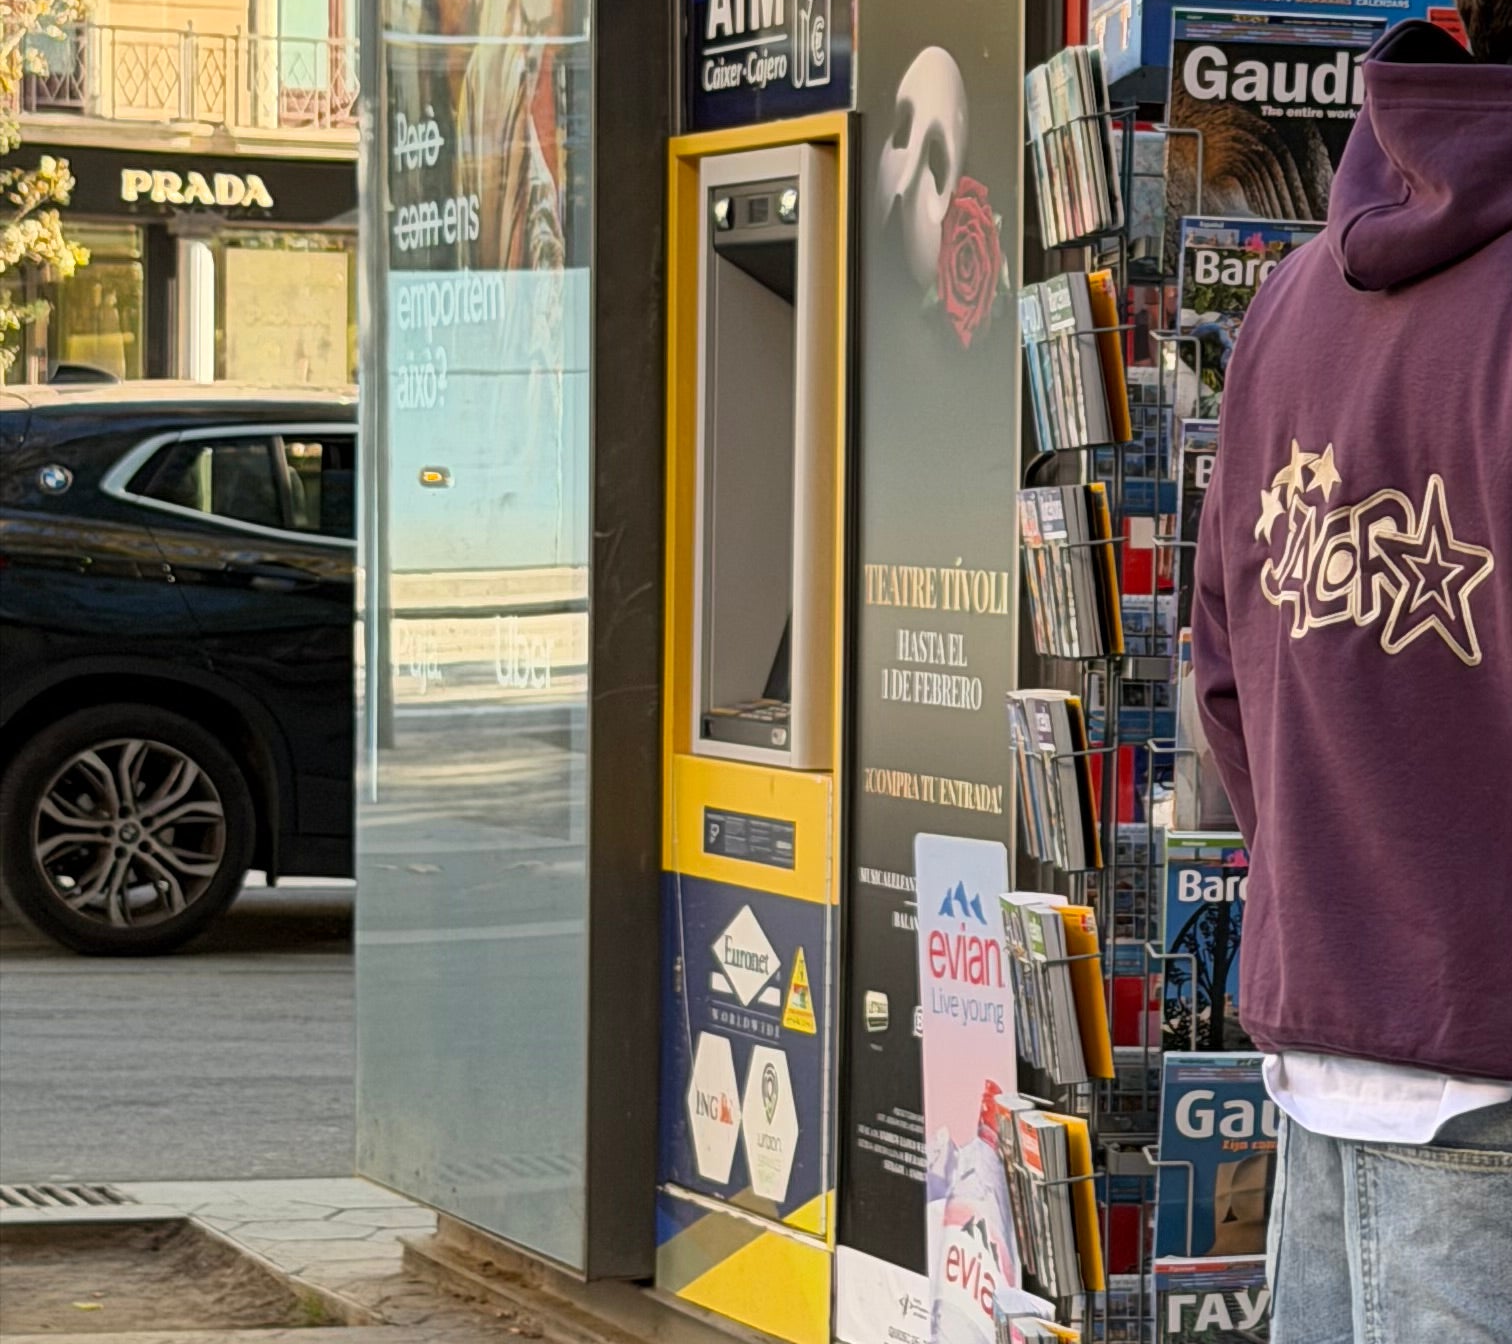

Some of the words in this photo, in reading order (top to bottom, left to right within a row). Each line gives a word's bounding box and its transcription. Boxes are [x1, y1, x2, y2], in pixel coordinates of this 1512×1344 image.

[1183, 45, 1369, 105] Gaudí
[1261, 106, 1285, 117] The
[1286, 106, 1323, 118] entire
[120, 168, 274, 207] PRADA
[443, 193, 480, 245] ens
[398, 266, 505, 343] emportem
[864, 564, 937, 608] TEATRE
[940, 556, 1009, 614] TÍVOLI
[495, 615, 555, 689] Uber
[898, 629, 946, 665] HASTA
[948, 633, 968, 667] EL
[881, 668, 889, 699] 1
[891, 669, 912, 702] DE
[914, 670, 983, 711] FEBRERO
[940, 777, 1003, 815] ENTRADA!
[724, 935, 769, 976] Euronet
[711, 1007, 780, 1039] WORLDWIDE
[931, 987, 959, 1018] Live
[961, 997, 1005, 1034] young
[696, 1089, 719, 1121] ING
[1175, 1089, 1279, 1139] Gau
[946, 1244, 996, 1318] evia
[1168, 1288, 1271, 1333] ГАУ
